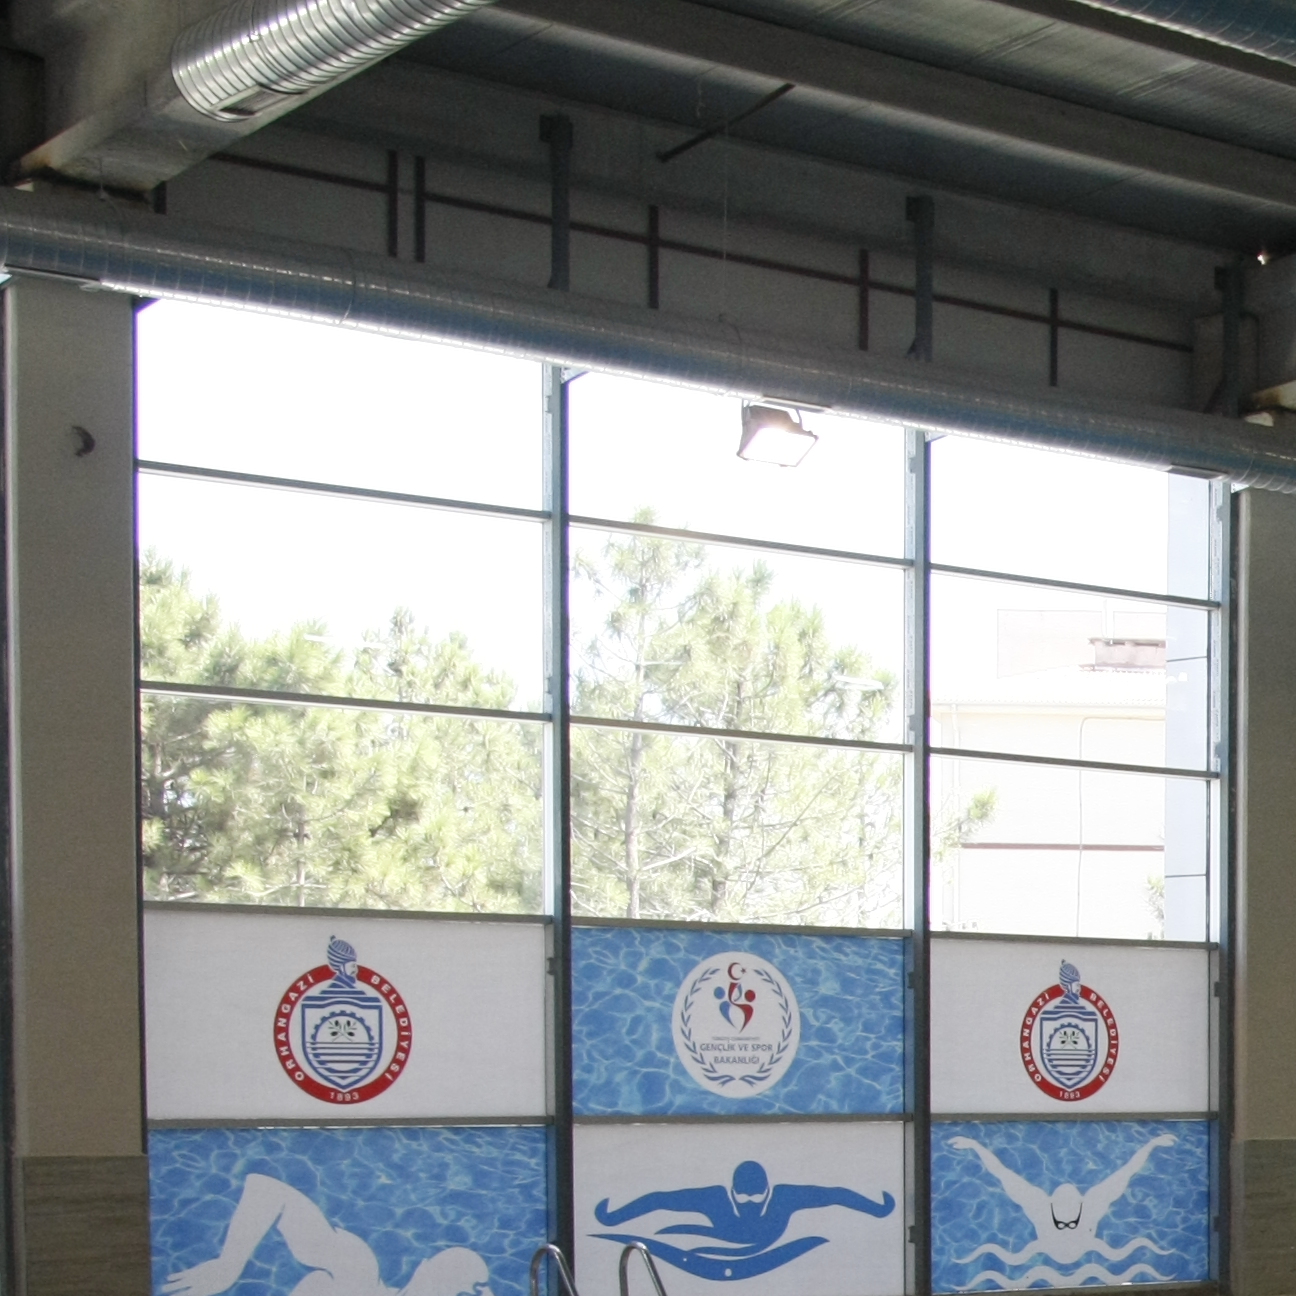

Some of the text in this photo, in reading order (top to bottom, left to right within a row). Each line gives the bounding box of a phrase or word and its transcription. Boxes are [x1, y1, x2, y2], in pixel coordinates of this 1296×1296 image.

[277, 973, 314, 1082] ORHANGAZİ
[738, 1043, 749, 1051] VE
[751, 1043, 773, 1052] SPOR
[330, 1091, 360, 1102] 1893
